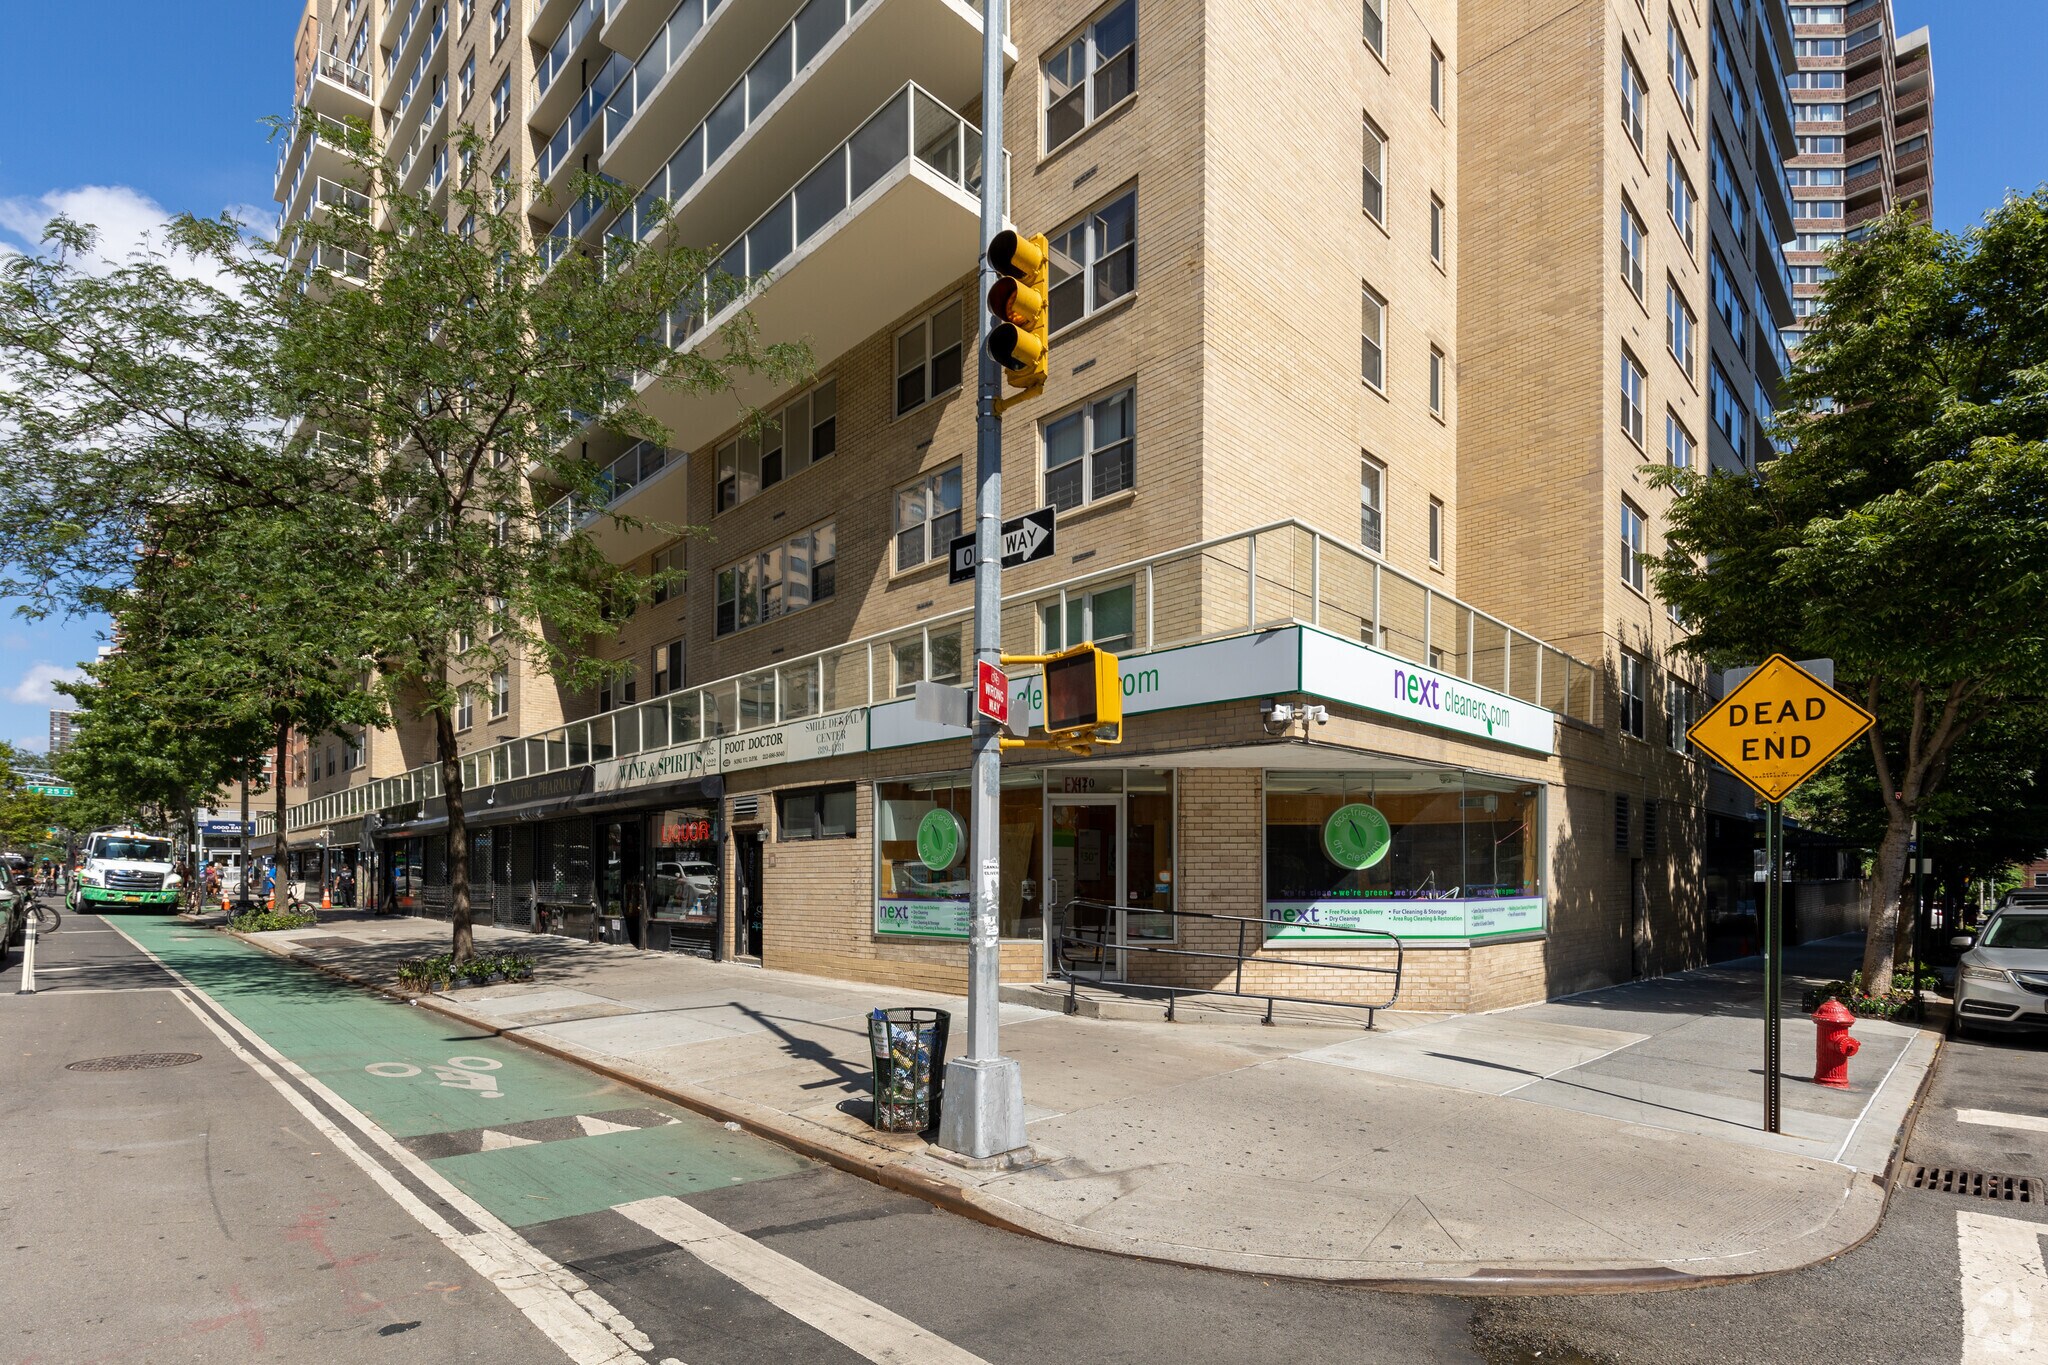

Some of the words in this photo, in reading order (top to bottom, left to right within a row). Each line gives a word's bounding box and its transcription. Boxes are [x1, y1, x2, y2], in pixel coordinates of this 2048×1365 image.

[1006, 527, 1037, 554] WAY
[985, 681, 1004, 703] WRONG
[1394, 669, 1440, 710] next
[1445, 687, 1510, 730] cleaners.com
[988, 698, 1001, 715] WAY
[1729, 697, 1826, 727] DEAD
[805, 719, 827, 733] SMILE
[816, 729, 846, 744] CENTER
[724, 740, 746, 755] FOOT
[748, 732, 784, 750] DOCTOR
[1742, 735, 1811, 761] END
[619, 760, 647, 782] WINE
[648, 762, 658, 778] &
[658, 750, 703, 776] SPIRITS
[510, 783, 533, 801] NUTRI
[537, 776, 573, 797] PHARMA
[922, 812, 953, 832] eco-friendly
[1334, 808, 1382, 828] eco-friendly
[661, 820, 710, 843] LIQUOR
[922, 843, 930, 858] dry
[930, 842, 954, 864] cleaning
[1333, 839, 1345, 855] dry
[1346, 840, 1383, 862] cleaning
[1339, 889, 1362, 897] we're
[1364, 889, 1388, 897] green
[880, 904, 909, 919] next
[1269, 906, 1320, 922] next
